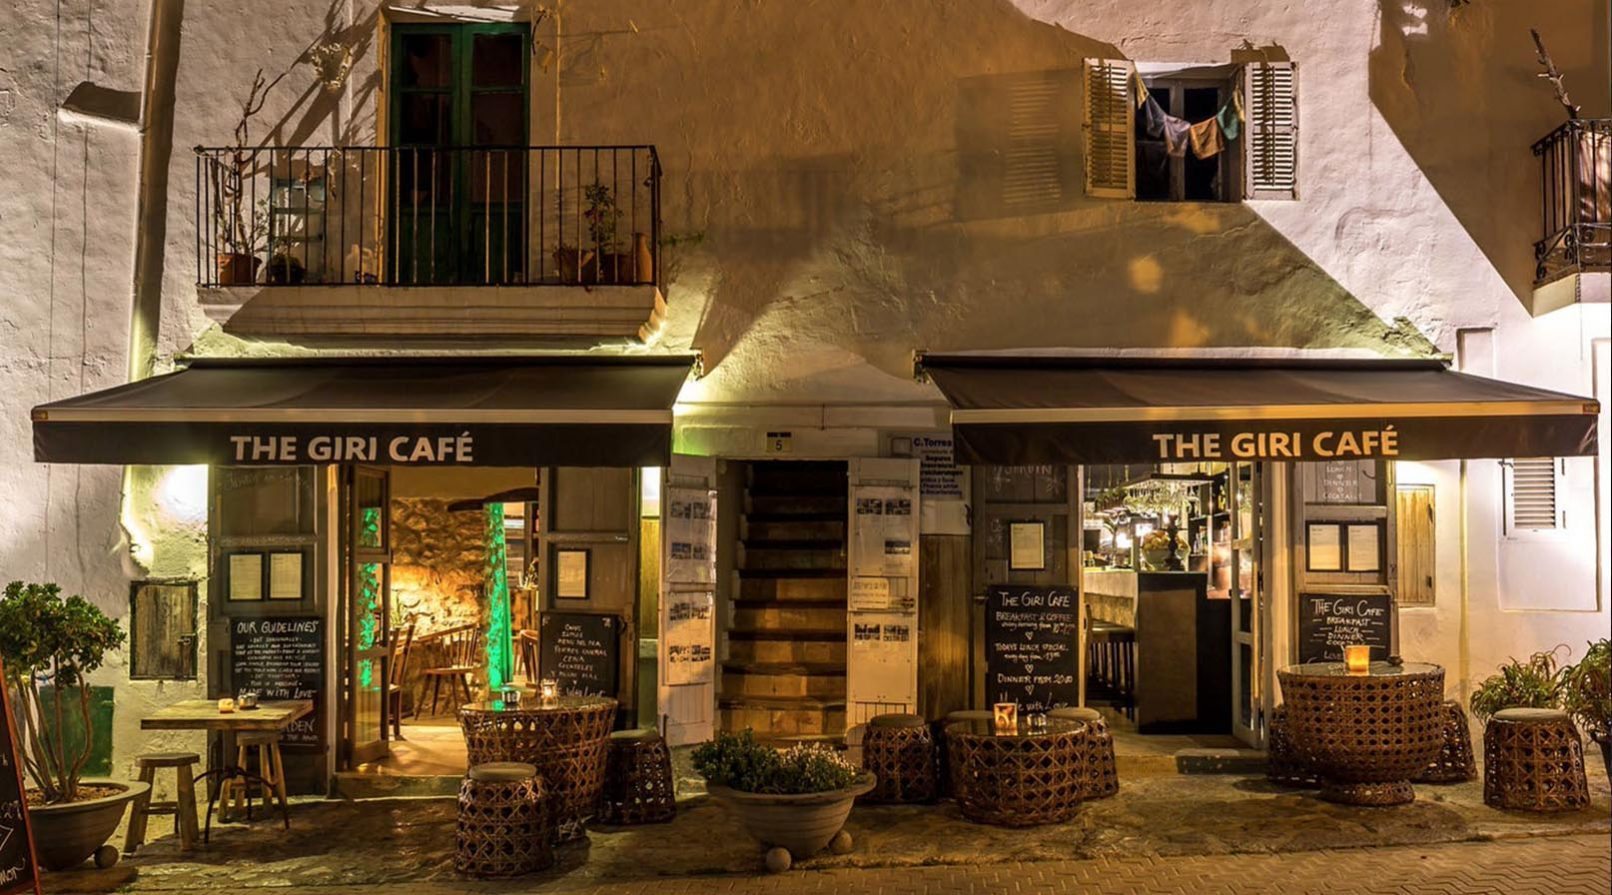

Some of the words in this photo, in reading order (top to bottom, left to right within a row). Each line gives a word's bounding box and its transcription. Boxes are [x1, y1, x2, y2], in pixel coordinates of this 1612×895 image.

[230, 436, 297, 461] THE
[307, 436, 377, 461] GIRI
[388, 431, 474, 462] CAFÉ
[1152, 433, 1221, 458] THE
[1231, 432, 1301, 457] GIRI
[1312, 425, 1399, 456] CAFÉ
[999, 591, 1018, 607] THE
[1021, 591, 1045, 607] GIRI
[1310, 598, 1333, 616] THE
[1333, 598, 1354, 616] GIRI
[237, 621, 258, 634] OUR
[261, 620, 319, 633] GUIDELINES
[997, 673, 1032, 684] DINNER
